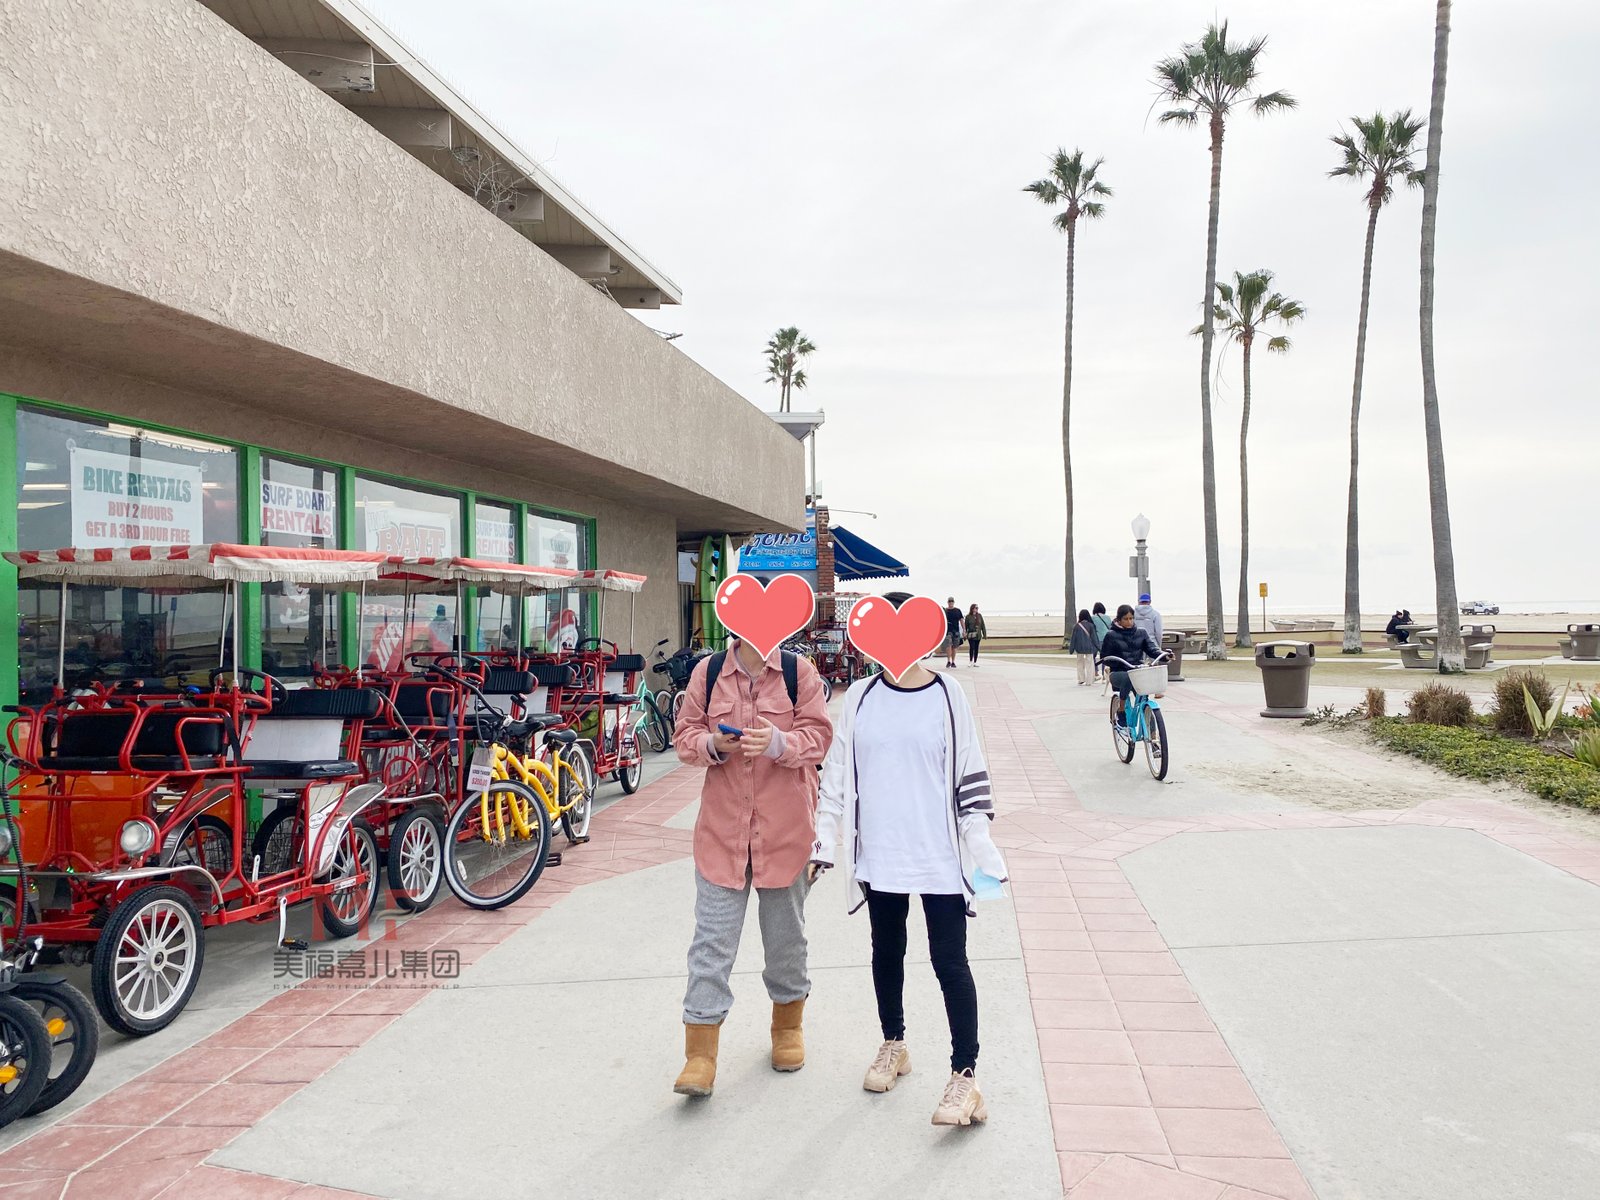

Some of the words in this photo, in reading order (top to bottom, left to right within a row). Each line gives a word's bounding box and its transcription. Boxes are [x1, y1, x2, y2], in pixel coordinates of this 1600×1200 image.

[83, 466, 123, 495] BIKE
[127, 472, 192, 503] RENTALS
[262, 484, 293, 507] SURF
[296, 488, 332, 512] BOARD
[108, 501, 130, 518] BUY
[132, 502, 139, 518] 2
[141, 504, 174, 522] HOURS
[262, 507, 332, 538] RENTALS
[86, 520, 107, 538] GET
[109, 522, 118, 539] A
[119, 523, 141, 540] 3RD
[142, 525, 168, 542] HOUR
[170, 527, 190, 544] FREE
[376, 521, 446, 557] BAIT
[477, 521, 492, 536] SURF
[494, 523, 514, 539] BOARD
[477, 538, 514, 556] RENTALS
